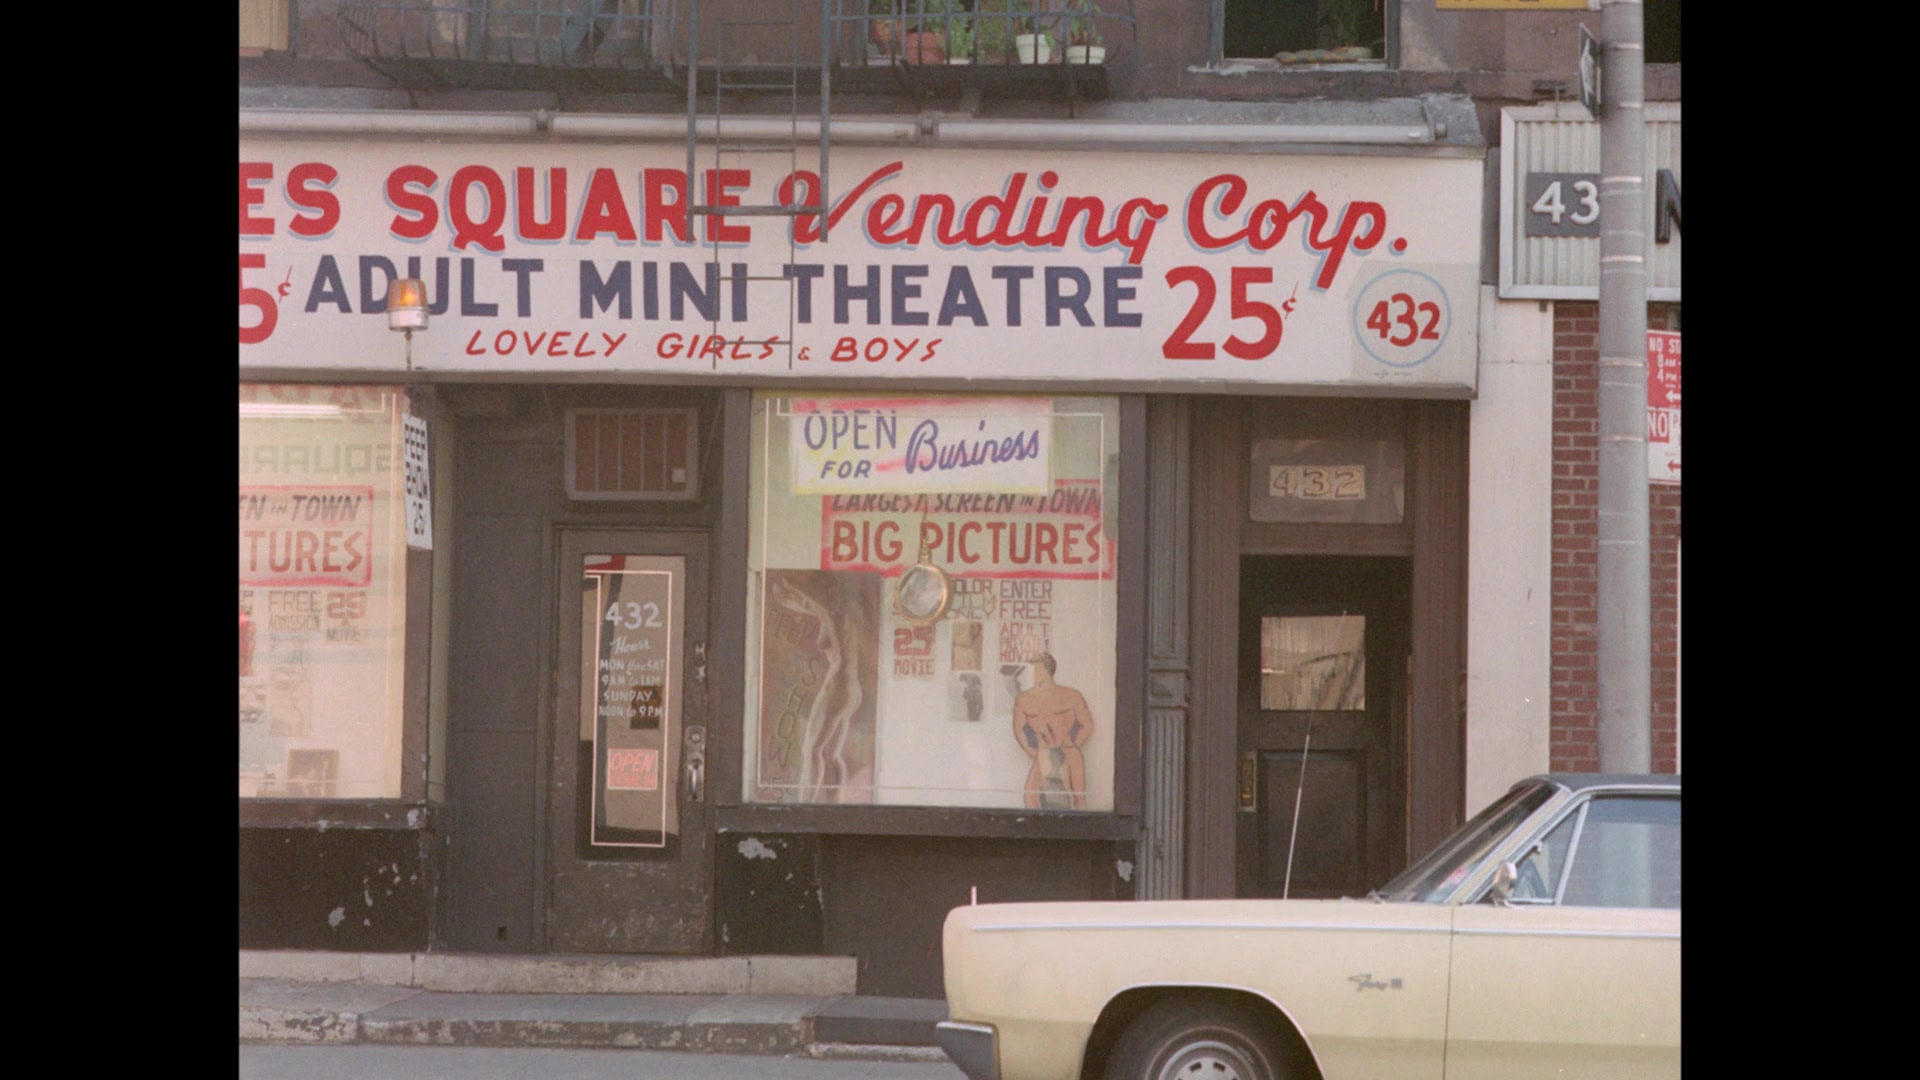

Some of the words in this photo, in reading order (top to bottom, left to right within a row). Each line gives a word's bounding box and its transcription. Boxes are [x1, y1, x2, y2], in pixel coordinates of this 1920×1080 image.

[239, 162, 341, 237] ES
[386, 164, 752, 252] SQUARE
[778, 161, 1168, 265] Vending
[1187, 173, 1408, 289] Corp.
[304, 254, 544, 318] ADULT
[579, 260, 749, 323] MINI
[783, 264, 1144, 328] THEATRE
[1366, 293, 1440, 348] 432
[465, 330, 627, 357] LOVELY
[656, 333, 780, 360] GIRLS
[797, 346, 811, 361] &
[831, 336, 943, 363] BOYS
[1649, 336, 1664, 353] NO
[1657, 353, 1664, 368] 8
[804, 409, 898, 451] OPEN
[1648, 411, 1668, 438] NO
[820, 459, 872, 479] FOR
[905, 419, 1040, 474] Business
[1272, 466, 1361, 498] 432
[291, 496, 363, 521] TOWN
[244, 530, 363, 574] TURES
[832, 519, 904, 562] BIG
[918, 521, 1102, 565] PICTURES
[953, 578, 993, 595] OLOR
[1000, 579, 1053, 599] ENTER
[268, 590, 323, 613] FREE
[1000, 600, 1052, 620] FREE
[605, 600, 663, 630] 432
[1000, 622, 1050, 637] ADULT
[599, 659, 625, 672] MON
[647, 659, 665, 673] SAT
[893, 658, 935, 676] MOVIE
[603, 690, 653, 702] SUNDAY
[610, 751, 656, 772] OPEN
